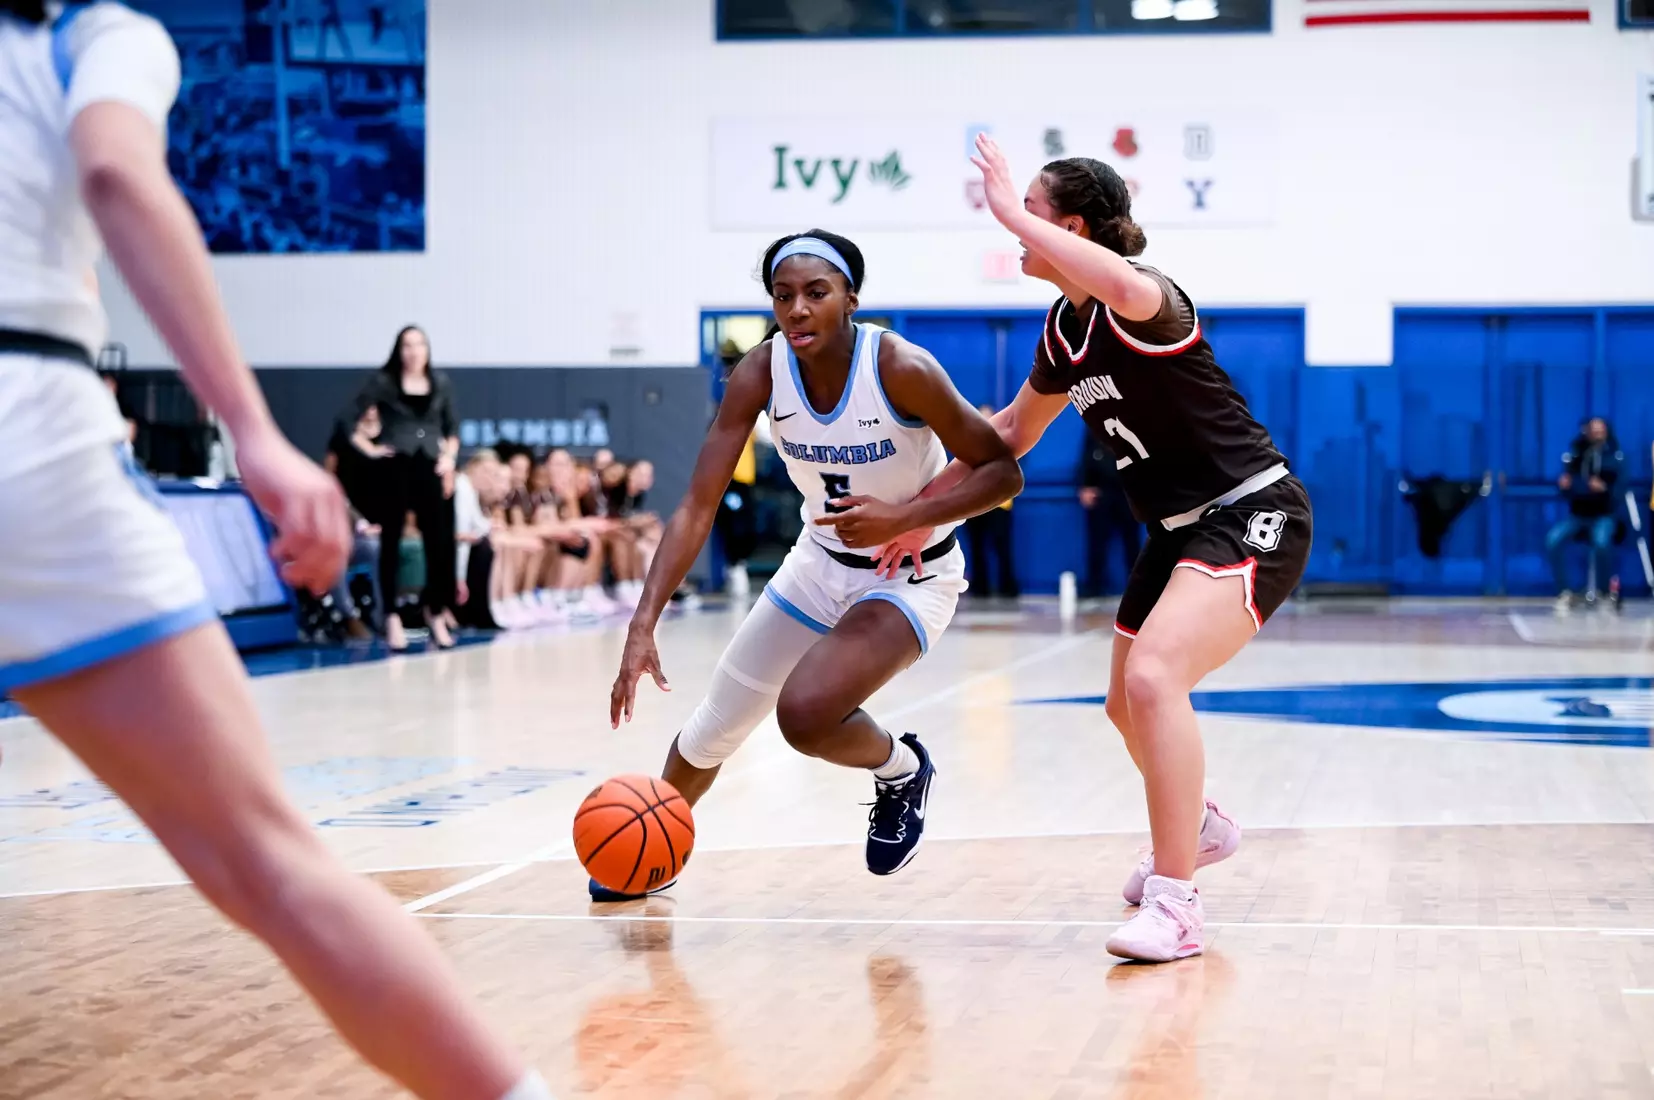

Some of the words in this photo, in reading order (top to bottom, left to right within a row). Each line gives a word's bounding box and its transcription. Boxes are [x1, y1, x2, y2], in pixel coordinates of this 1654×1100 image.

[773, 146, 859, 204] Ivy
[459, 418, 609, 446] OLUMBIA
[858, 419, 873, 428] Ivy
[780, 436, 897, 465] COLUMBIA
[1243, 510, 1287, 552] B
